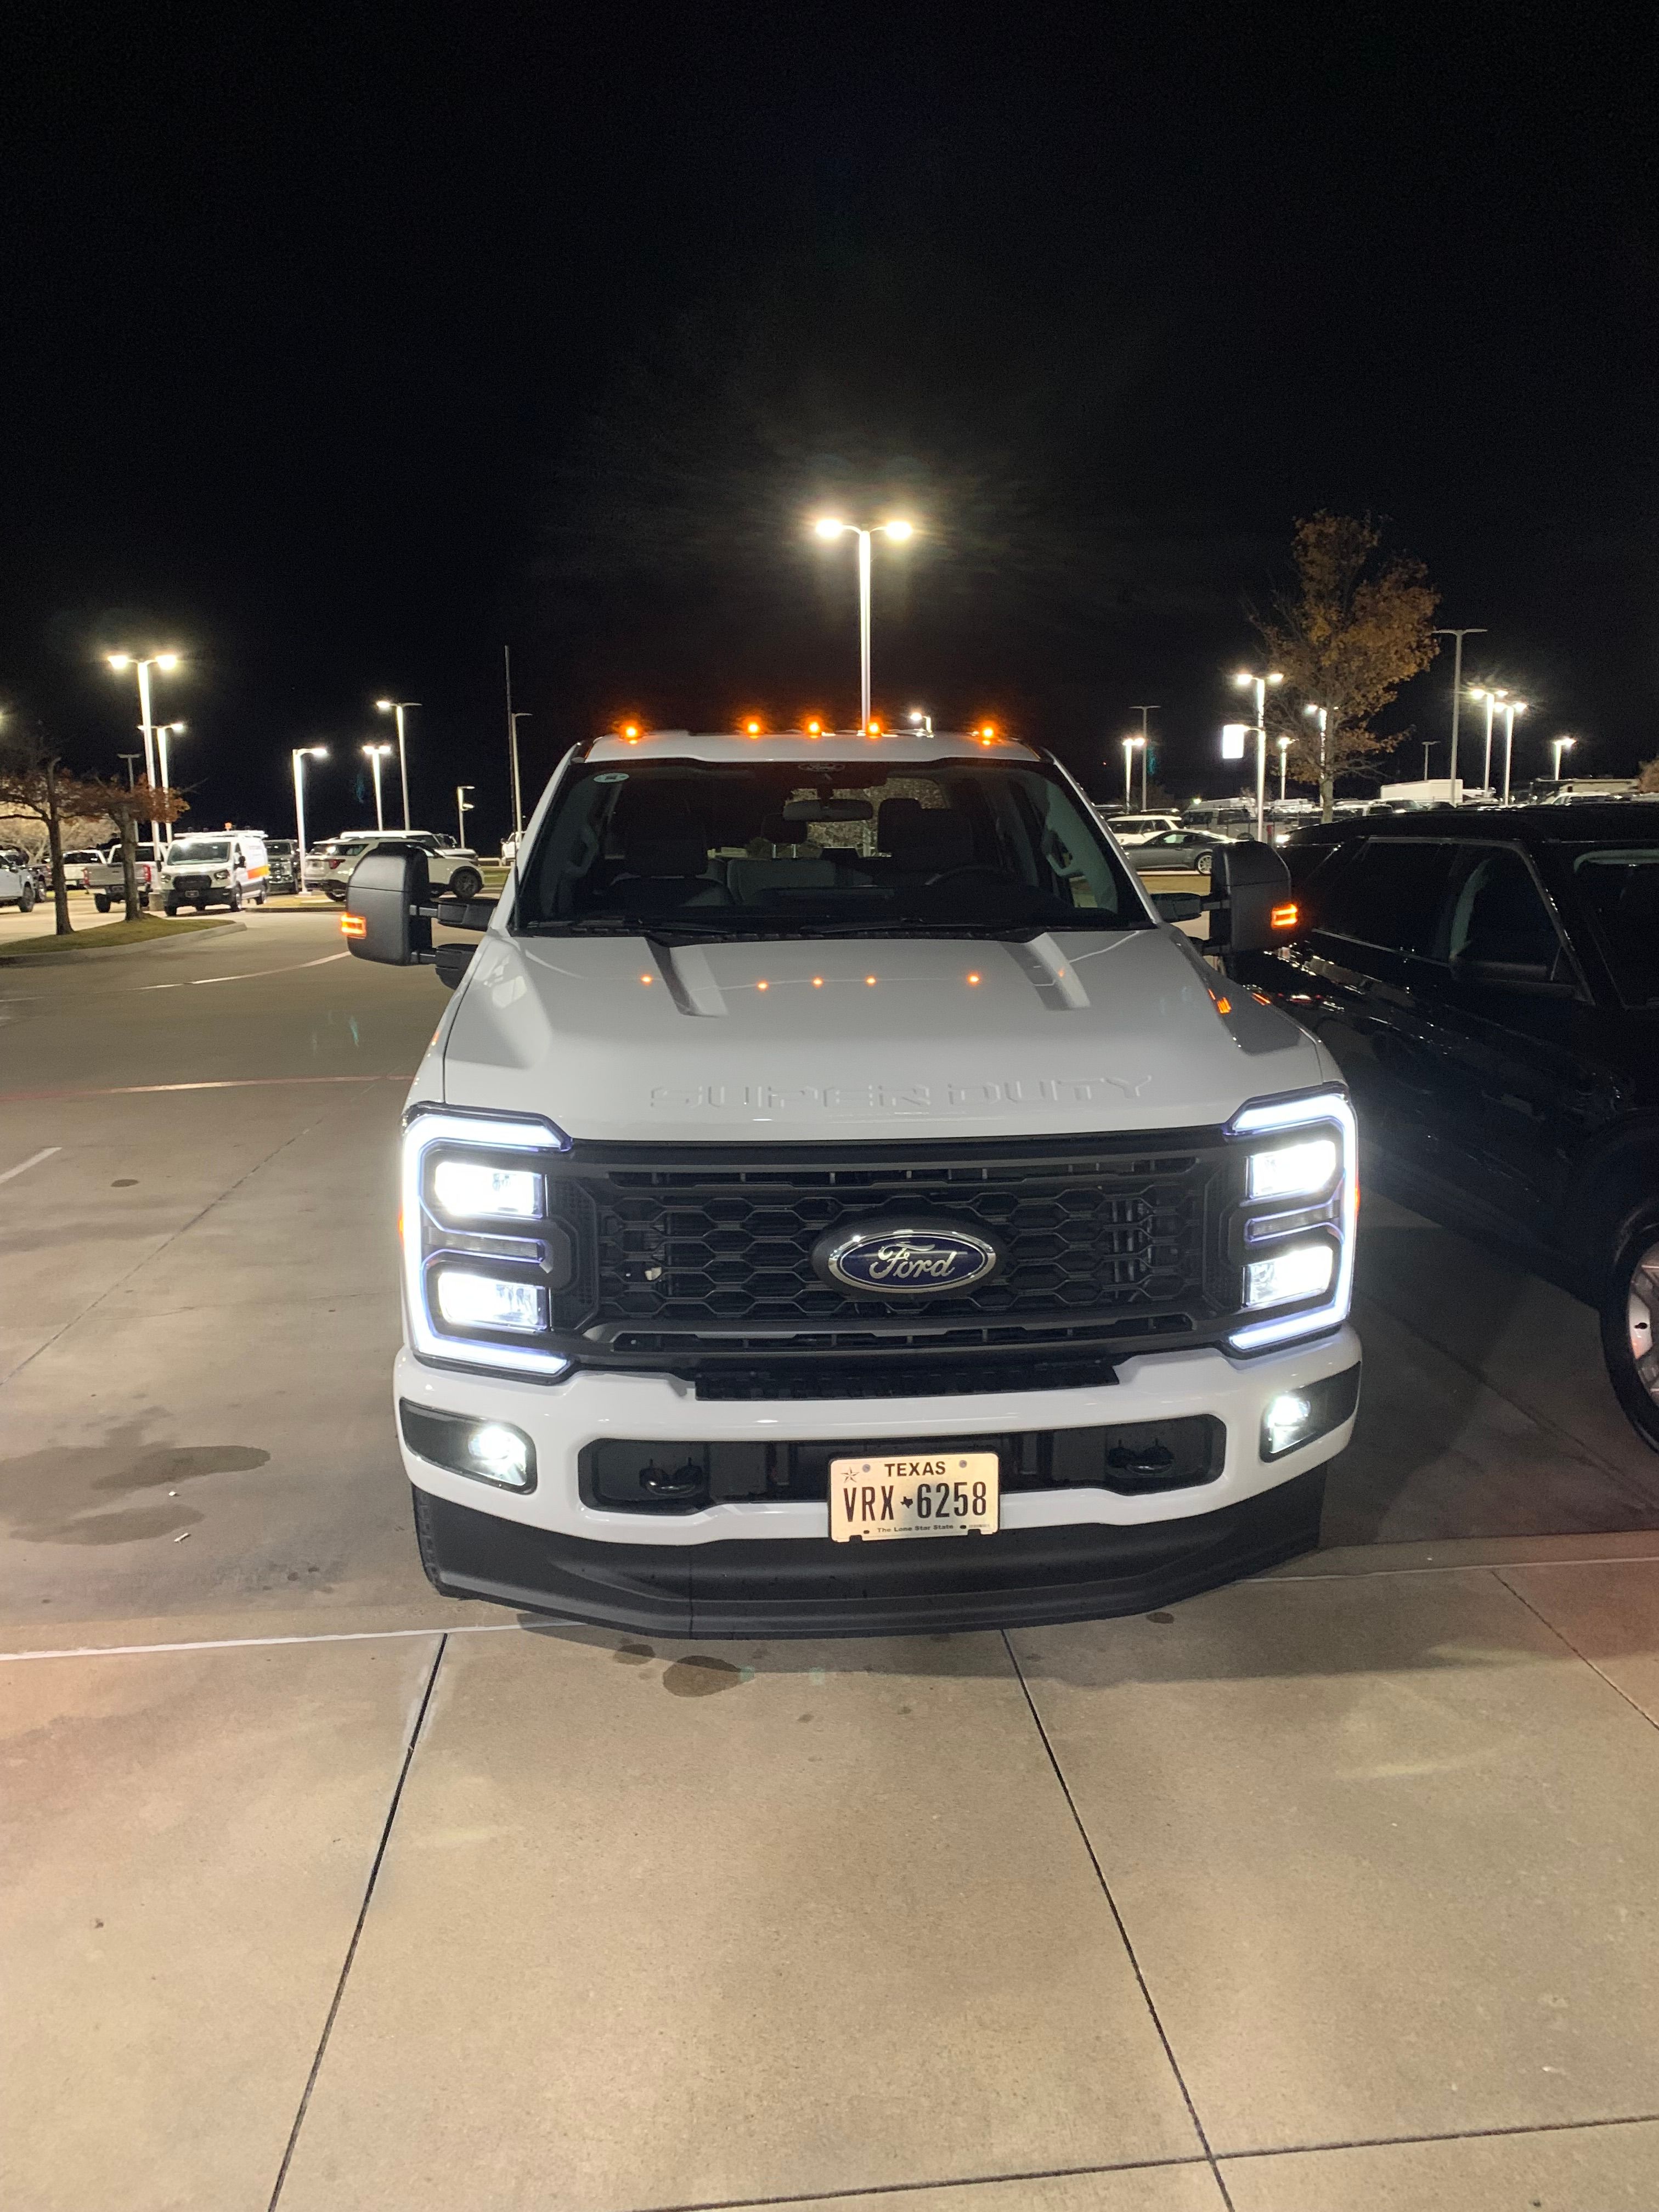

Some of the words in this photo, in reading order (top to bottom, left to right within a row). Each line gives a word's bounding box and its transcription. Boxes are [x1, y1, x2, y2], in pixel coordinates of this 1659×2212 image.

[649, 1084, 931, 1108] SUPER
[947, 1075, 1152, 1106] DUTY
[869, 1242, 957, 1279] Ford
[884, 1462, 946, 1477] TEXAS
[844, 1485, 894, 1522] VRX
[917, 1482, 986, 1518] 6258
